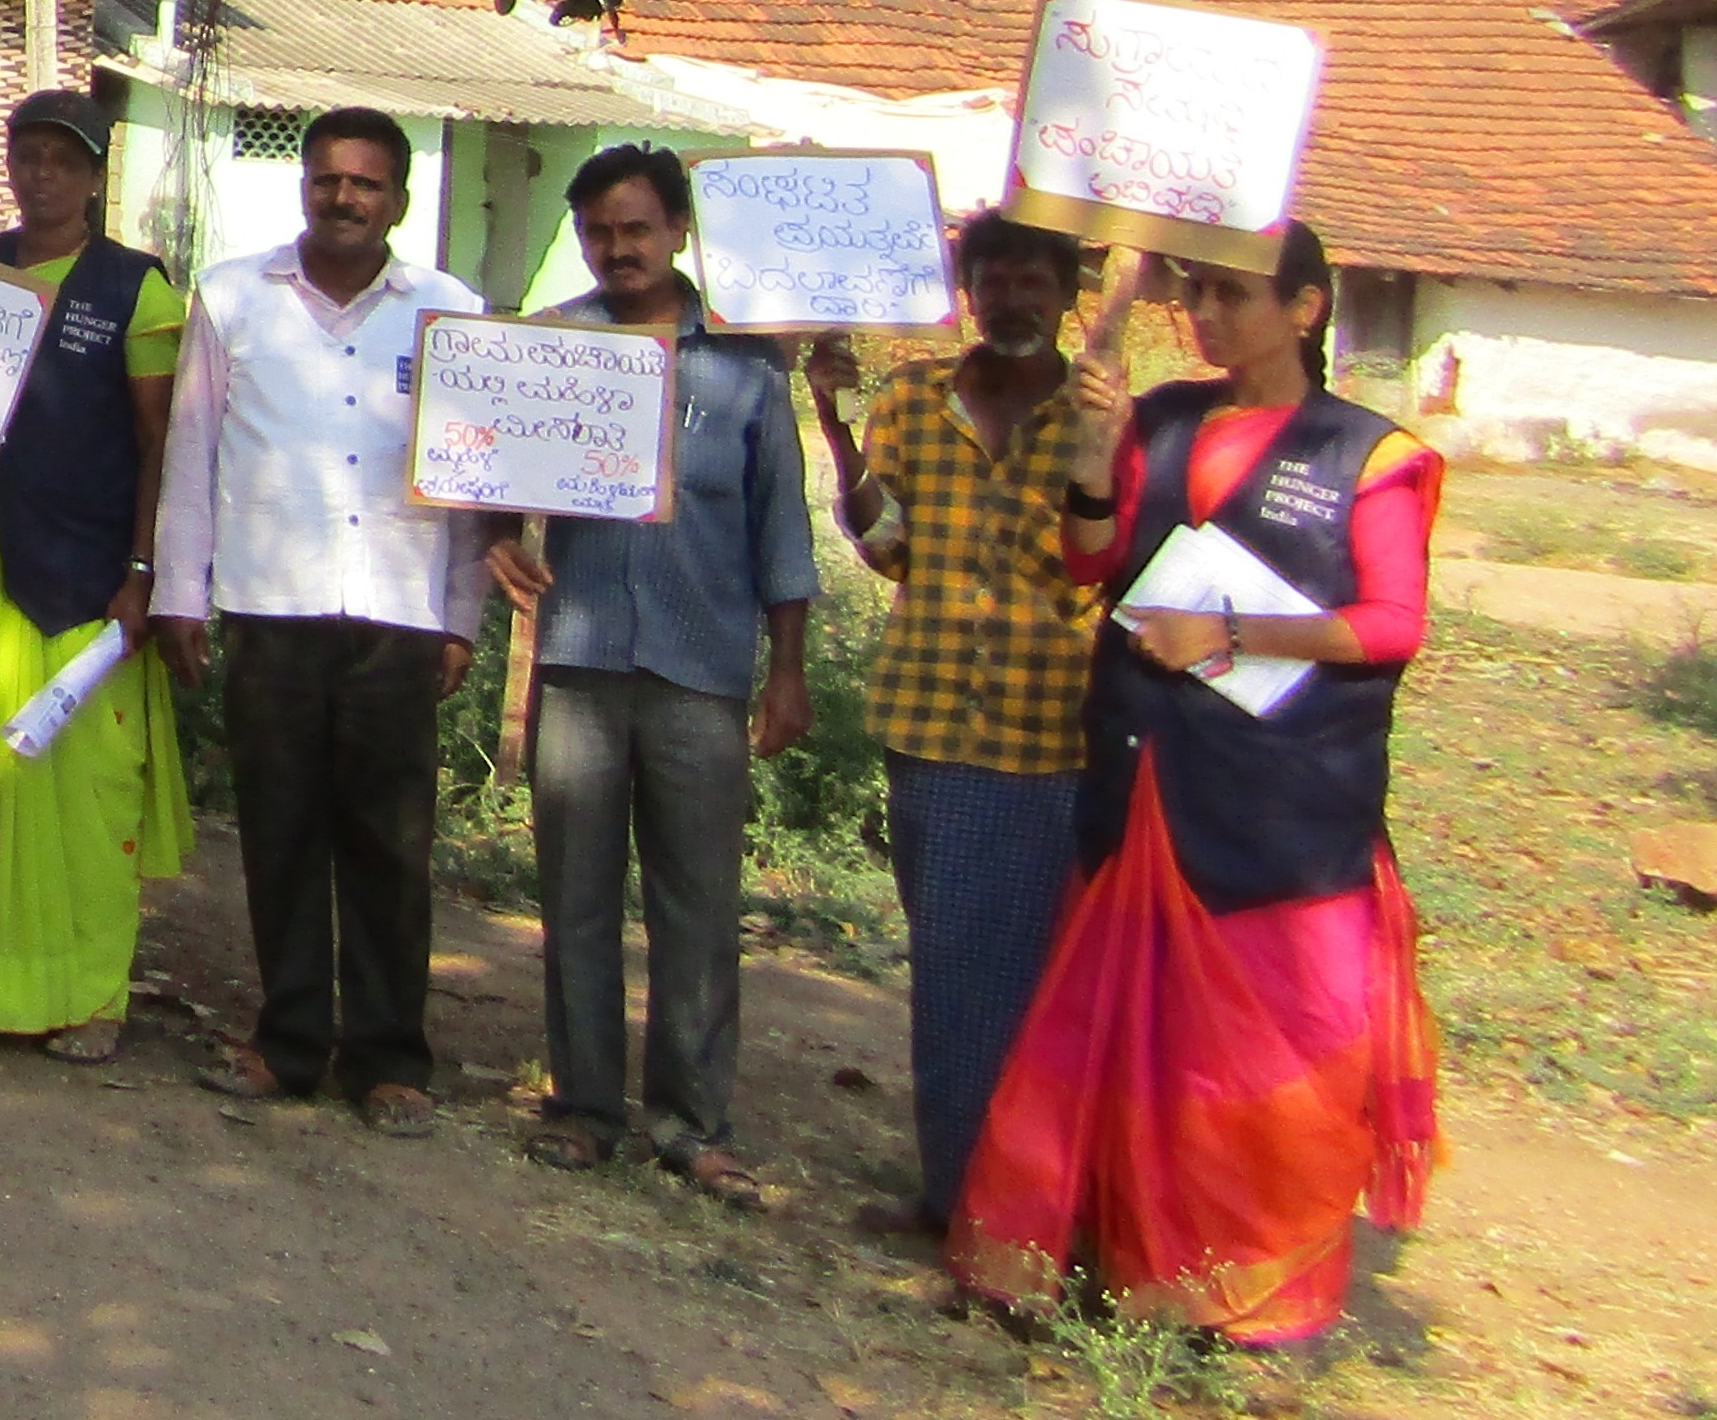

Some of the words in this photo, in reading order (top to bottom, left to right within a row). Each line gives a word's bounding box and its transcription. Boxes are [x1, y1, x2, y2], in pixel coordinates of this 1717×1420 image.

[62, 324, 113, 346] PROJECT
[65, 312, 118, 333] HUNGER
[444, 421, 496, 450] 50%
[581, 448, 642, 479] 50%
[1279, 460, 1310, 476] THE
[1269, 473, 1341, 504] HUNGER
[1259, 506, 1298, 527] India
[1265, 489, 1336, 521] PROJECT
